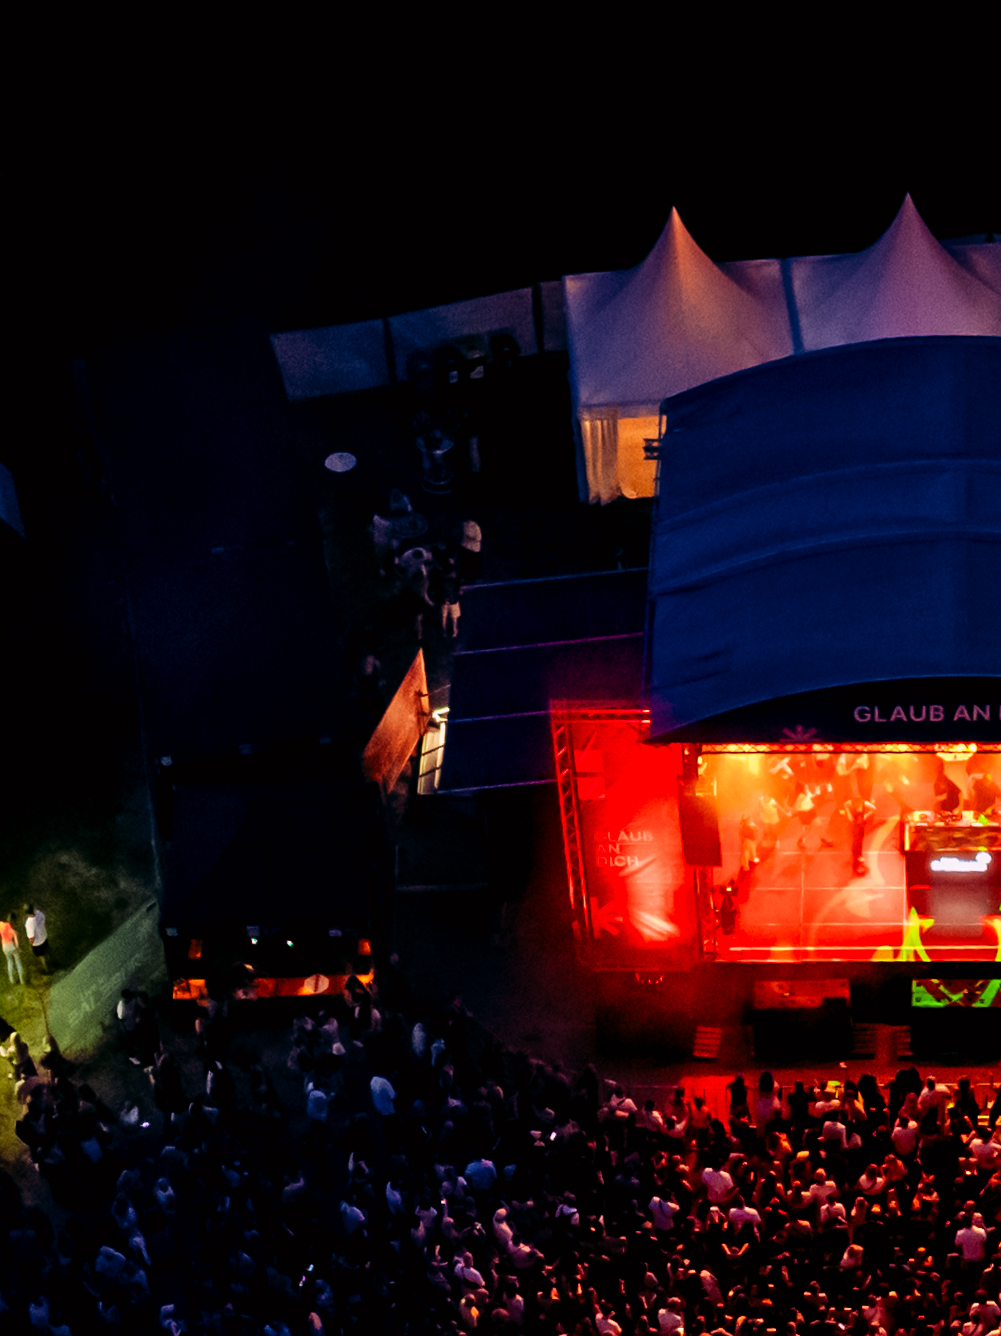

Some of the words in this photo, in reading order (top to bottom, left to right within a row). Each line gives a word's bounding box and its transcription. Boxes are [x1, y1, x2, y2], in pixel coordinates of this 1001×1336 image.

[853, 704, 945, 723] GLAUB
[952, 704, 990, 722] AN
[595, 830, 654, 843] LAUB
